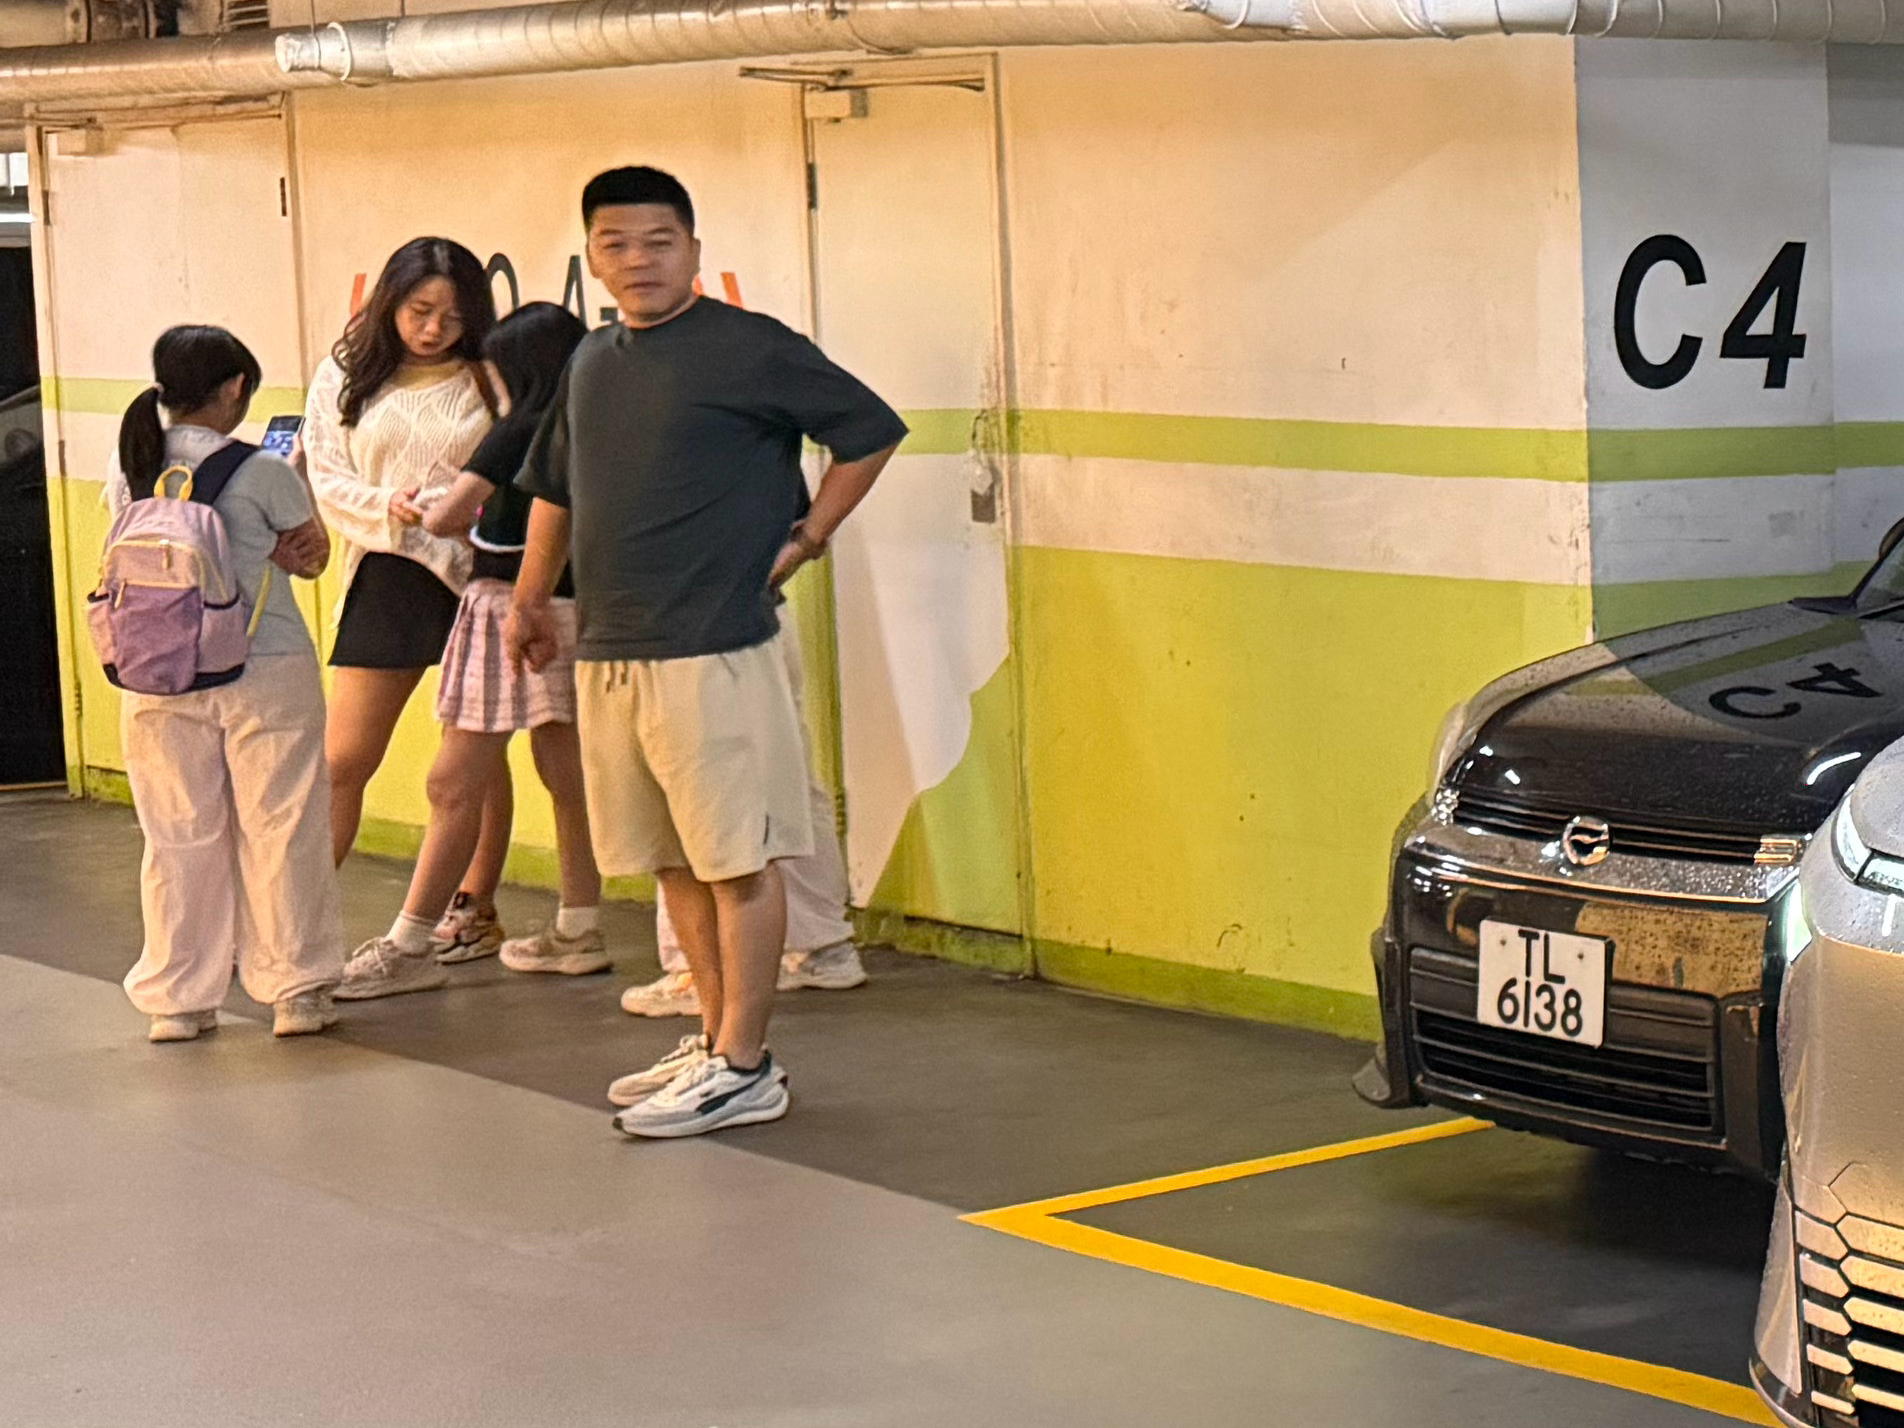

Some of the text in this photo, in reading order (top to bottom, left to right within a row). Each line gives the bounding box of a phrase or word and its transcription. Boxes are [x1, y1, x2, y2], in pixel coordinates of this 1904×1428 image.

[1613, 233, 1808, 391] C4
[1517, 928, 1566, 985] TL
[1497, 977, 1583, 1038] 6138
